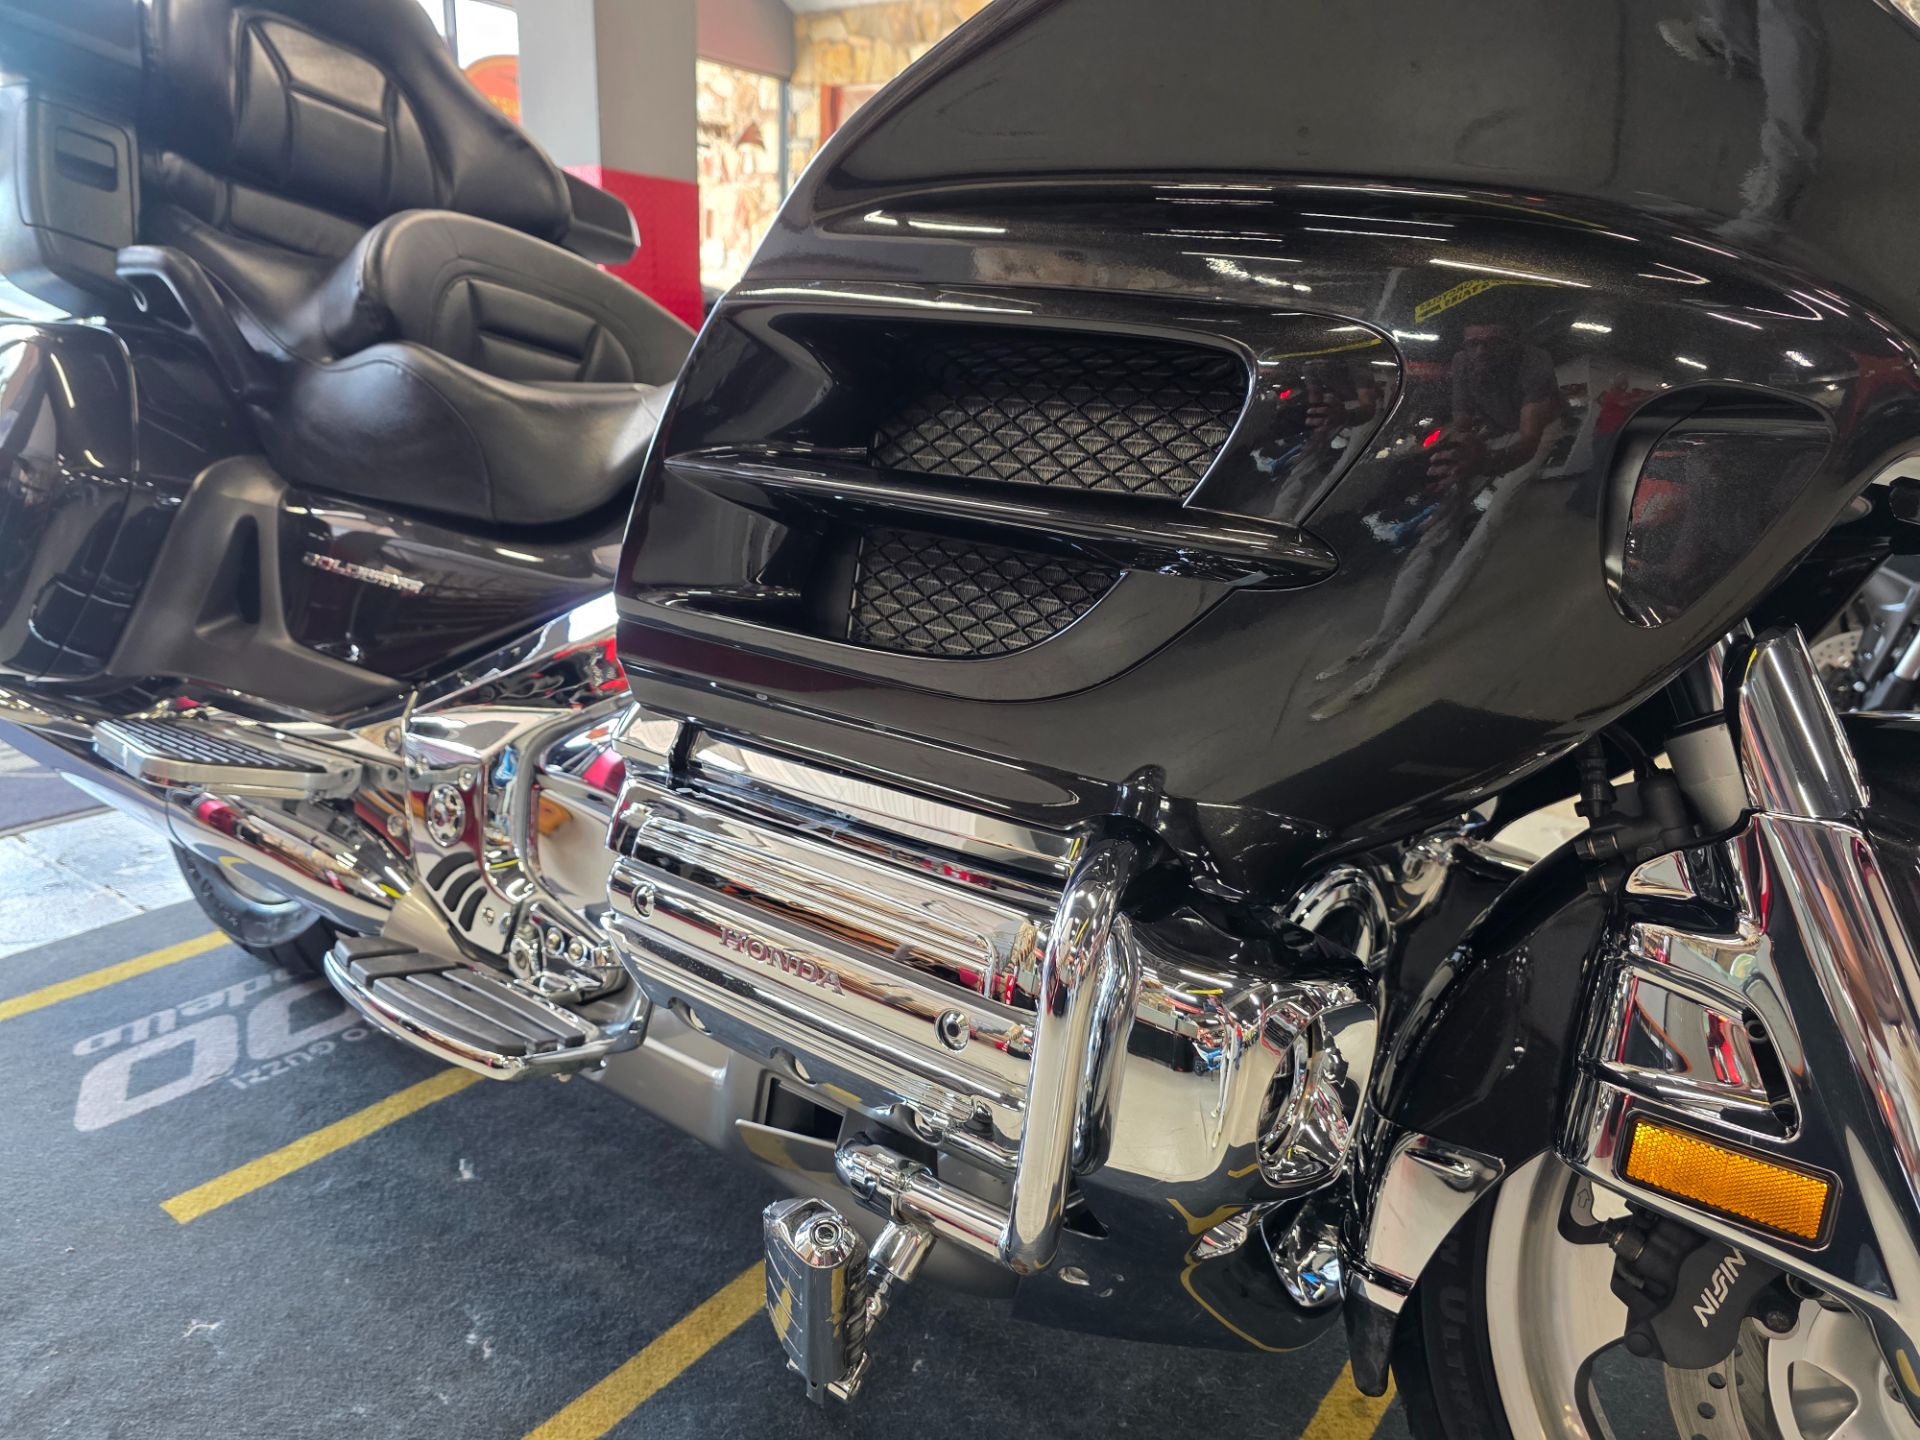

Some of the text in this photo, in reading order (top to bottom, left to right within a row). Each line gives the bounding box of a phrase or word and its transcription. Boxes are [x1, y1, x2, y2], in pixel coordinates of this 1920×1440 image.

[718, 924, 846, 998] HONDA
[229, 1040, 336, 1090] GUZZI
[1693, 1246, 1747, 1329] NISSIN
